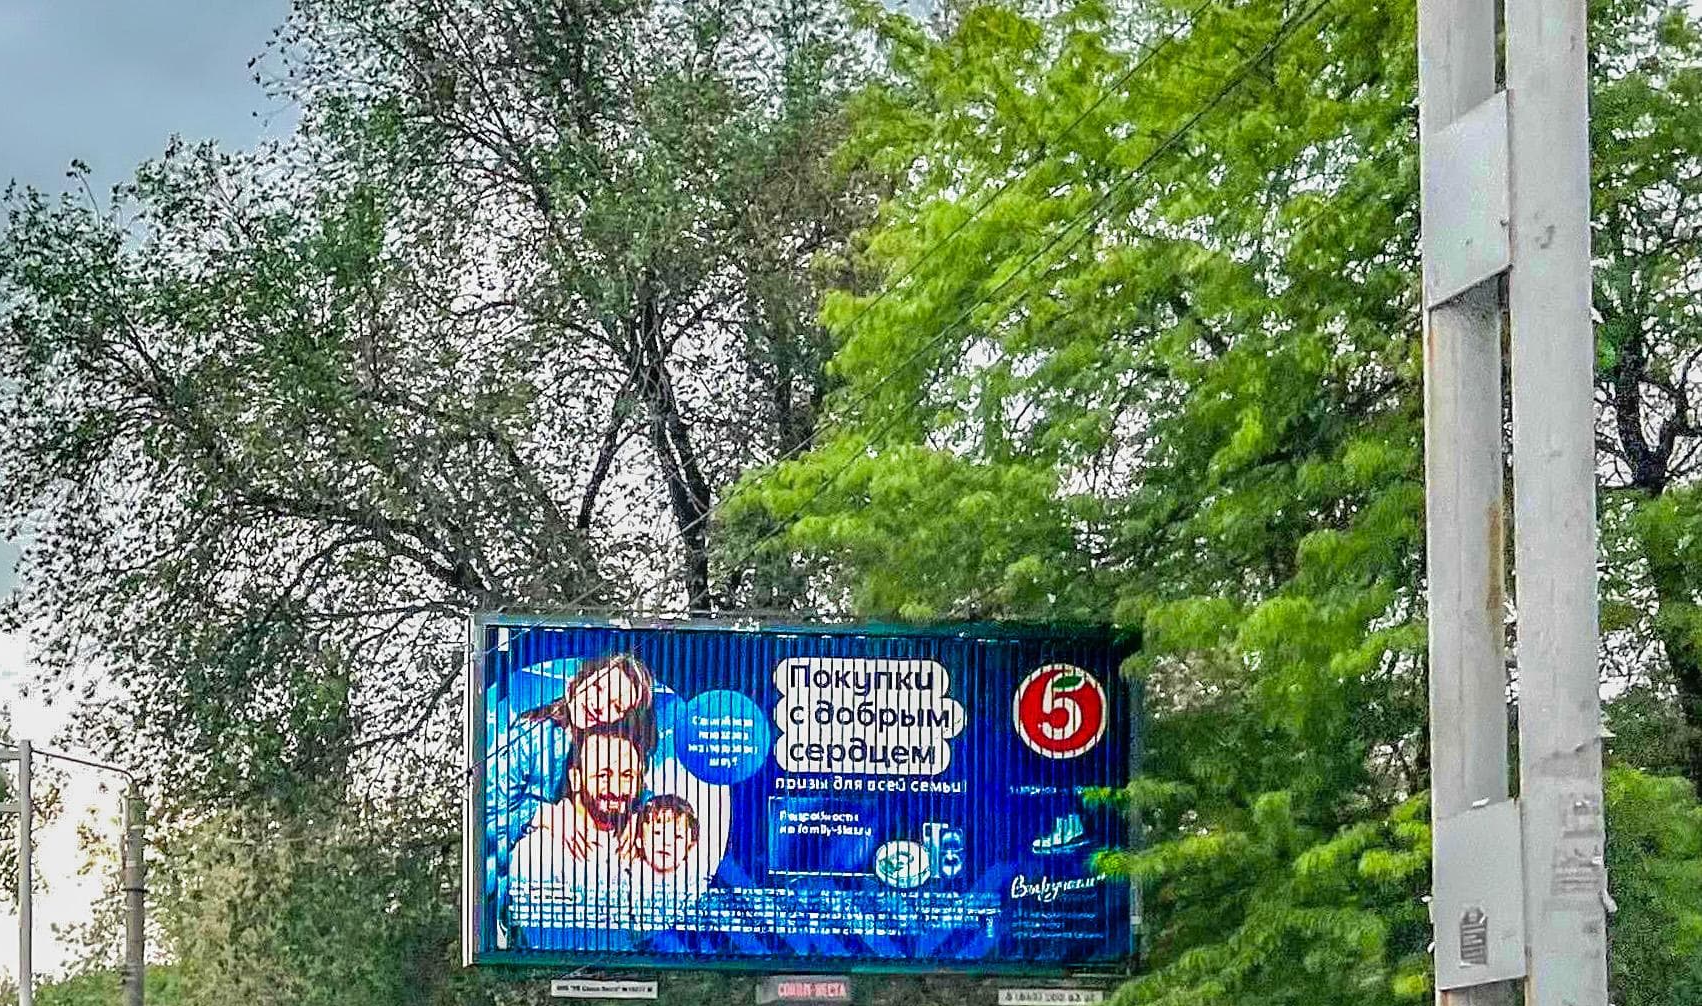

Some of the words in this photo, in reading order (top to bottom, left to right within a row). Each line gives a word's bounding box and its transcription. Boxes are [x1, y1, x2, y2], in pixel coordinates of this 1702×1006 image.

[790, 664, 934, 697] Покупки
[789, 705, 805, 725] с
[814, 700, 950, 733] добрым
[789, 737, 936, 768] сердцем
[775, 776, 828, 791] призы
[833, 775, 863, 791] для
[867, 777, 906, 792] всей
